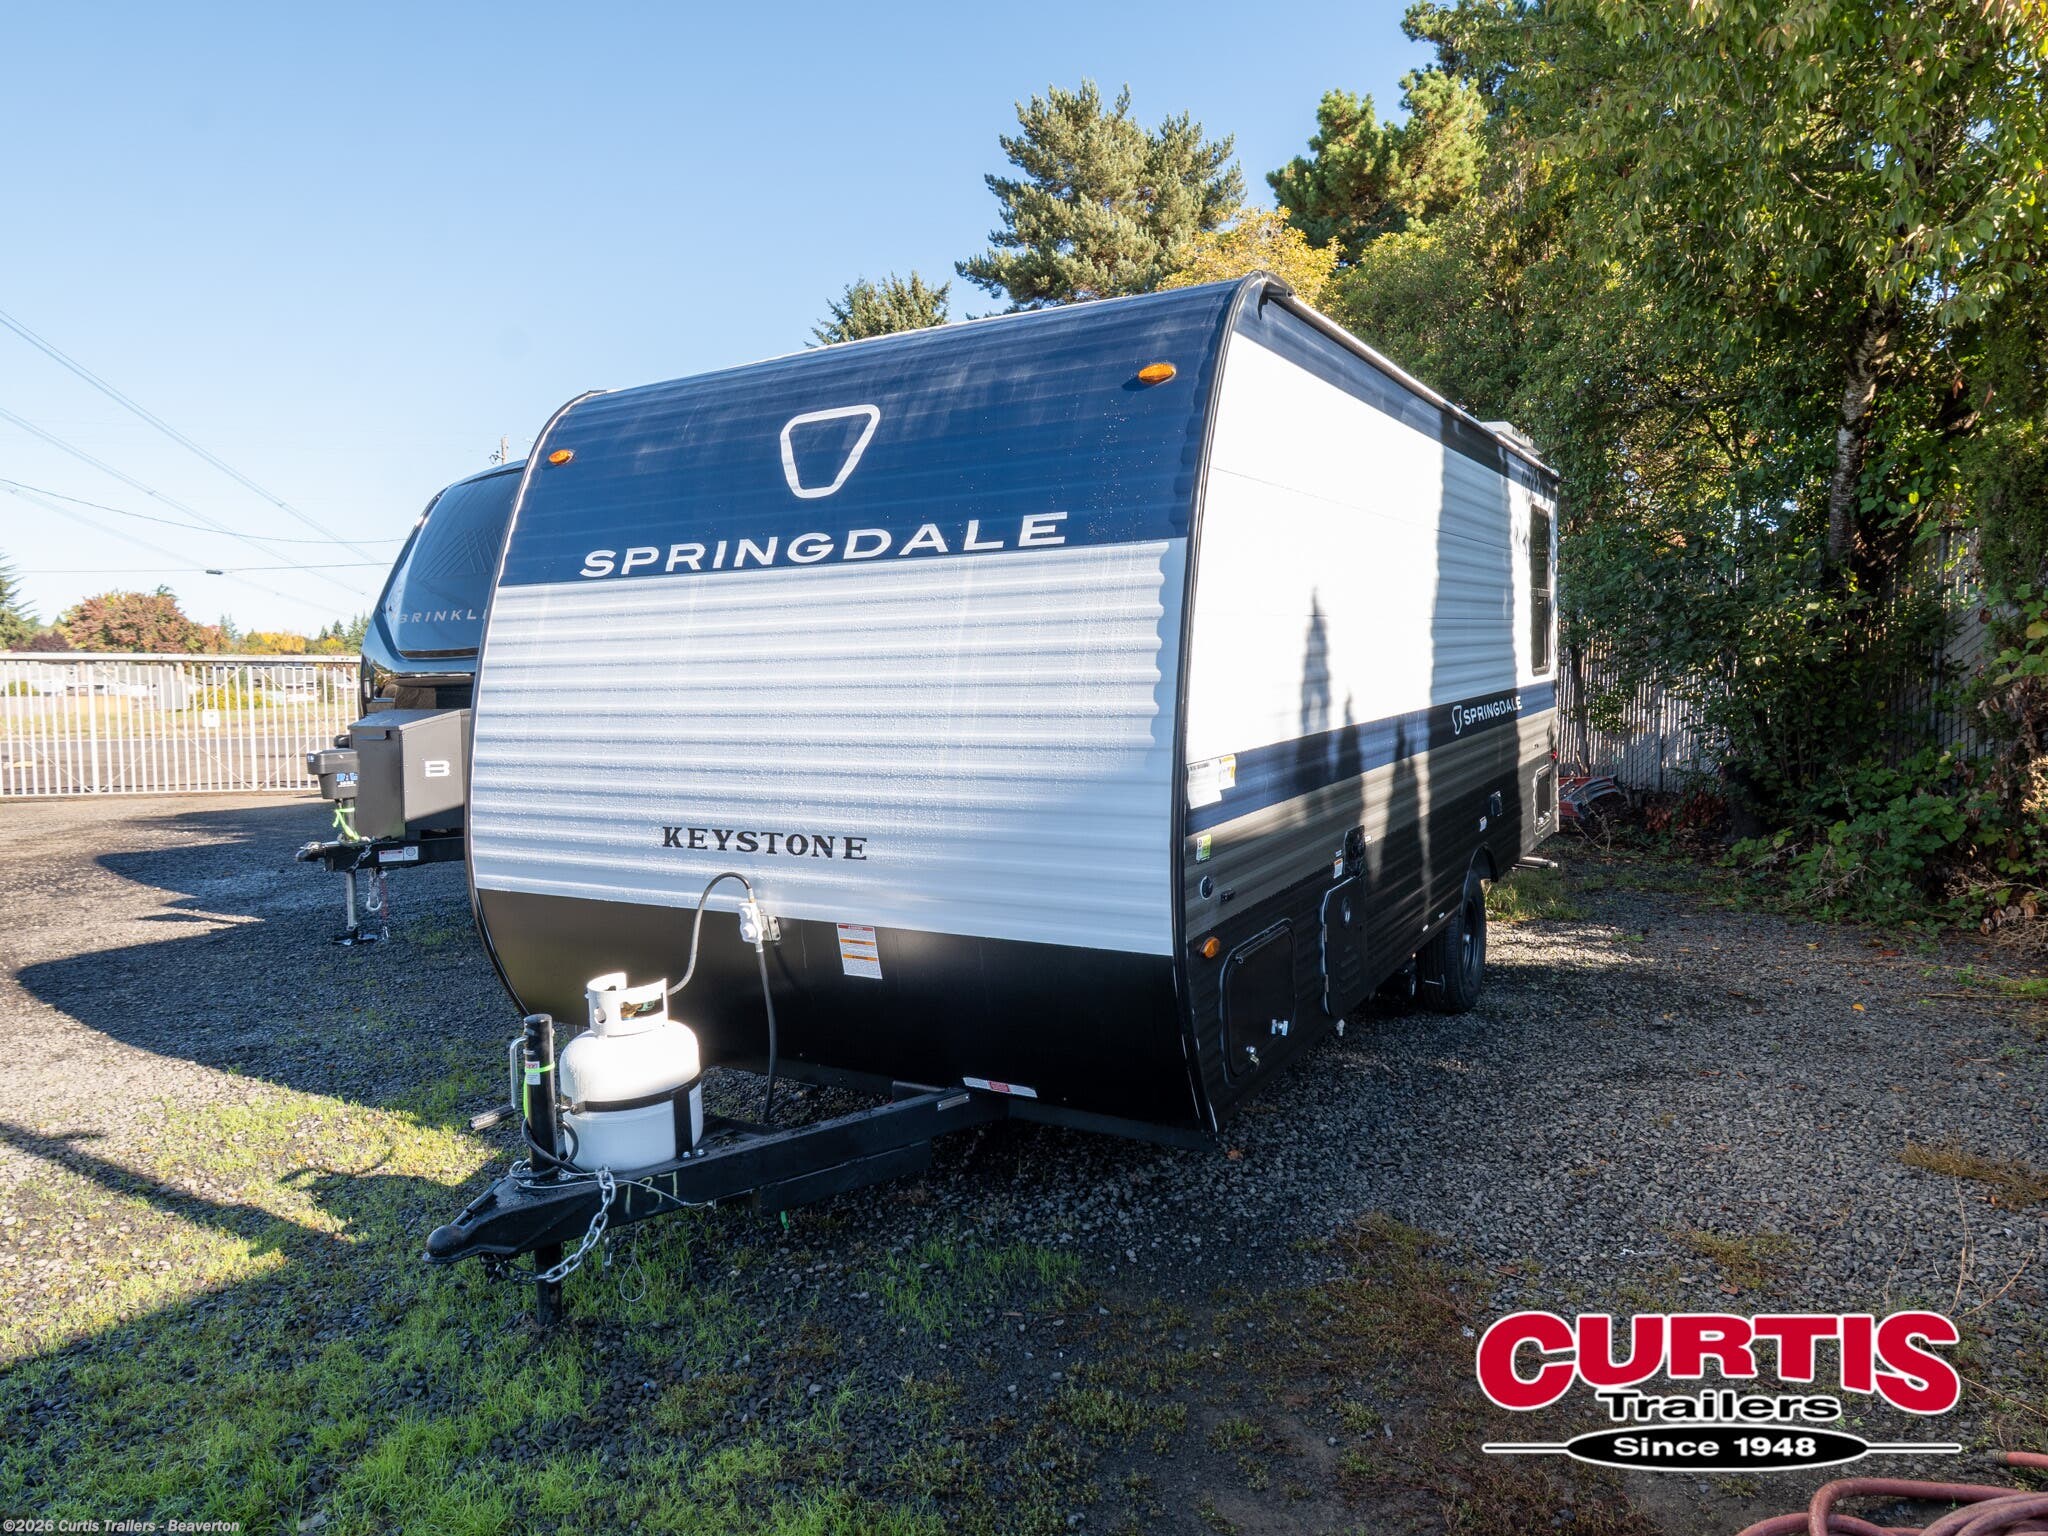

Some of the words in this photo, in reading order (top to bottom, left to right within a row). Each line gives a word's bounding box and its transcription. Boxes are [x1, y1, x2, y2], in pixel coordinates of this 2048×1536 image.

[579, 511, 1068, 578] SPRINGDALE
[399, 609, 488, 624] BRINKL
[1463, 695, 1523, 725] SPRINGDALE
[662, 826, 868, 860] KEYSTONE
